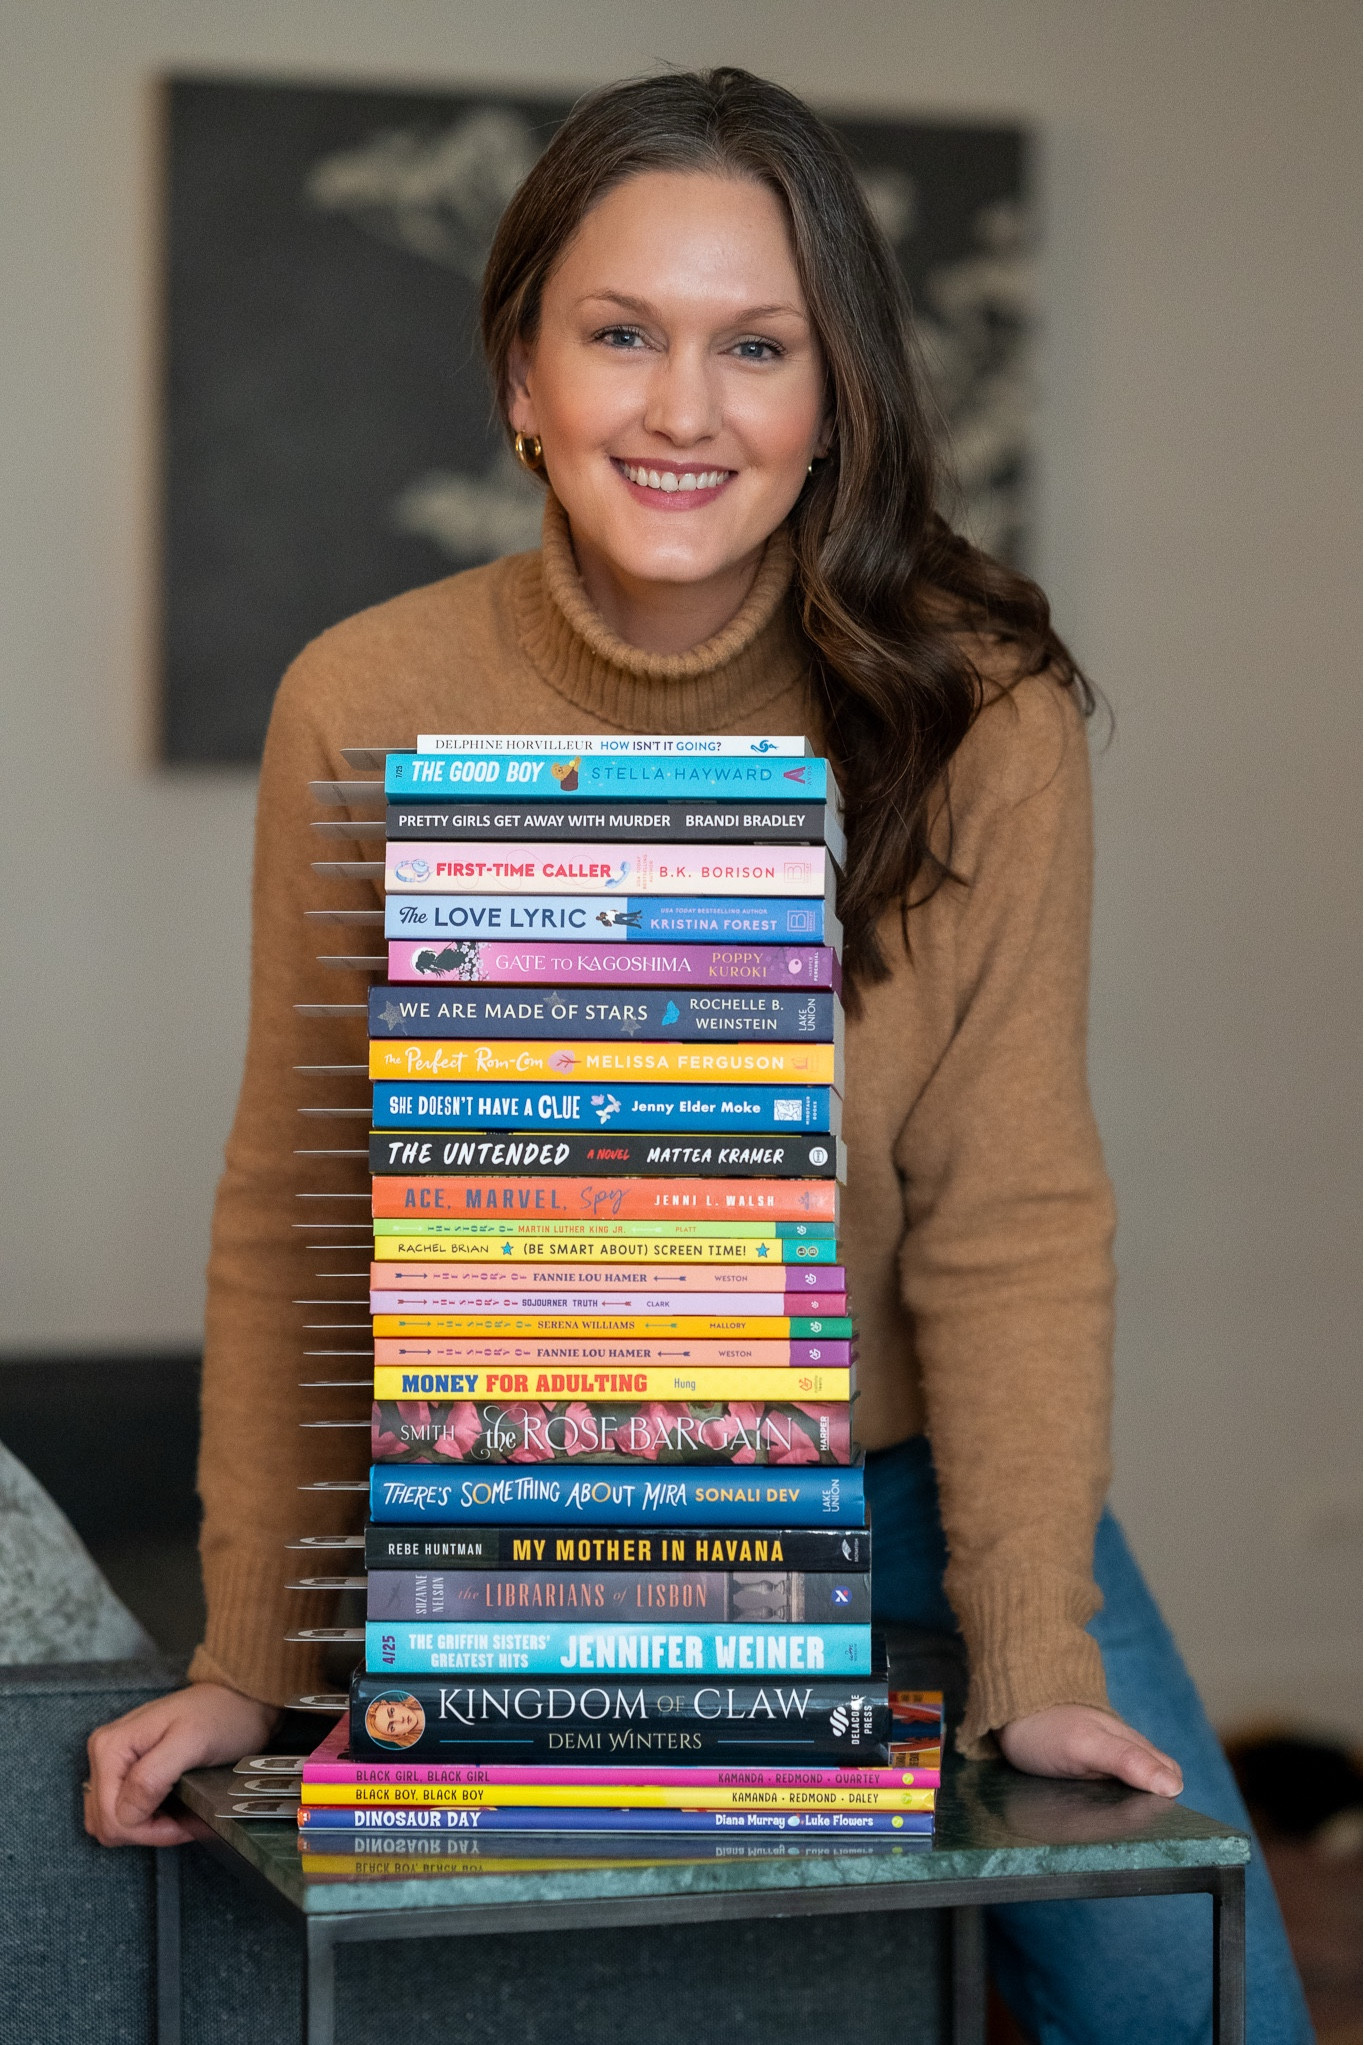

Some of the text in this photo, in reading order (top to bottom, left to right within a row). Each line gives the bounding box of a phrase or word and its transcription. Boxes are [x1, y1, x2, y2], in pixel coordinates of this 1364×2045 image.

[435, 740, 592, 751] DELPHINE HORVILLEUR
[601, 741, 722, 752] HOW ISN'T IT GOING?
[412, 761, 544, 783] THE GOOD BOY
[592, 767, 772, 782] STELLA HAYWARD
[399, 815, 670, 828] PRETTY GIRLS GET AWAY WITH MURDER
[686, 815, 805, 827] BRANDI BRADLEY
[437, 863, 610, 878] FIRST-TIME CALLER
[660, 866, 775, 878] B.K. BORISON
[400, 907, 586, 928] The LOVE LYRIC
[651, 918, 777, 931] KRISTINA FOREST
[496, 954, 691, 972] GATE TO KAGOSHIMA
[712, 953, 762, 964] POPPY
[709, 965, 767, 978] KUROKI
[399, 1003, 648, 1020] WE ARE MADE OF STARS
[690, 999, 783, 1011] ROCHELLE B.
[807, 999, 816, 1030] UNION
[696, 1017, 777, 1030] WEINSTEIN
[385, 1047, 543, 1073] The Perfect Rom-Com
[587, 1055, 784, 1069] MELISSA FERGUSON
[390, 1094, 580, 1119] SHE DOESN'T HAVE A CLUE
[631, 1100, 761, 1115] Jenny Elder Moke
[388, 1142, 570, 1166] THE UNTENDED
[587, 1149, 630, 1160] A NOVEL
[647, 1148, 784, 1164] MATTEA KRAMER
[405, 1187, 631, 1215] ACE, MARVEL, Spy
[655, 1194, 774, 1206] JENNI L. WALSH
[518, 1225, 626, 1234] MARTIN LUTHER KING JR.
[398, 1242, 489, 1253] RACHEL BRIAN
[523, 1243, 746, 1257] (BE SMART ABOUT) SCREEN TIME!
[533, 1273, 647, 1282] FANNIE LOU HAMER
[522, 1298, 598, 1308] SOJOURNER TRUTH
[538, 1321, 635, 1329] SERENA WILLIAMS
[402, 1374, 648, 1393] MONEY FOR ADULTING
[674, 1377, 696, 1391] Hung
[401, 1425, 455, 1441] SMITH
[523, 1417, 619, 1450] ROSE
[630, 1416, 792, 1451] BARGAIN
[383, 1477, 687, 1511] THERE'S SOMETHING ABOUT MIRA
[696, 1489, 800, 1502] SONALI DEV
[389, 1543, 482, 1556] REBE HUNTMAN
[513, 1540, 783, 1562] MY MOTHER IN HAVANA
[416, 1574, 427, 1614] SUZANNE
[432, 1577, 444, 1613] NELSON
[458, 1584, 707, 1608] the LIBRARIANS of LISBON
[409, 1635, 550, 1650] THE GRIFFIN SISTERS'
[561, 1636, 703, 1669] JENNIFER
[715, 1636, 824, 1669] WEINER
[431, 1653, 528, 1668] GREATEST HITS
[439, 1688, 813, 1726] KINGDOM OF CLAW
[864, 1705, 872, 1734] PRESS
[549, 1729, 702, 1751] DEMI WINTERS
[356, 1771, 490, 1782] BLACK GIRL, BLACK GIRL
[719, 1774, 880, 1784] KAMANDA REDMOND QUARTEY
[356, 1789, 484, 1801] BLACK BOY, BLACK BOY
[354, 1811, 481, 1828] DINOSAUR DAY
[716, 1815, 873, 1829] Diana Murray Luke Flowers
